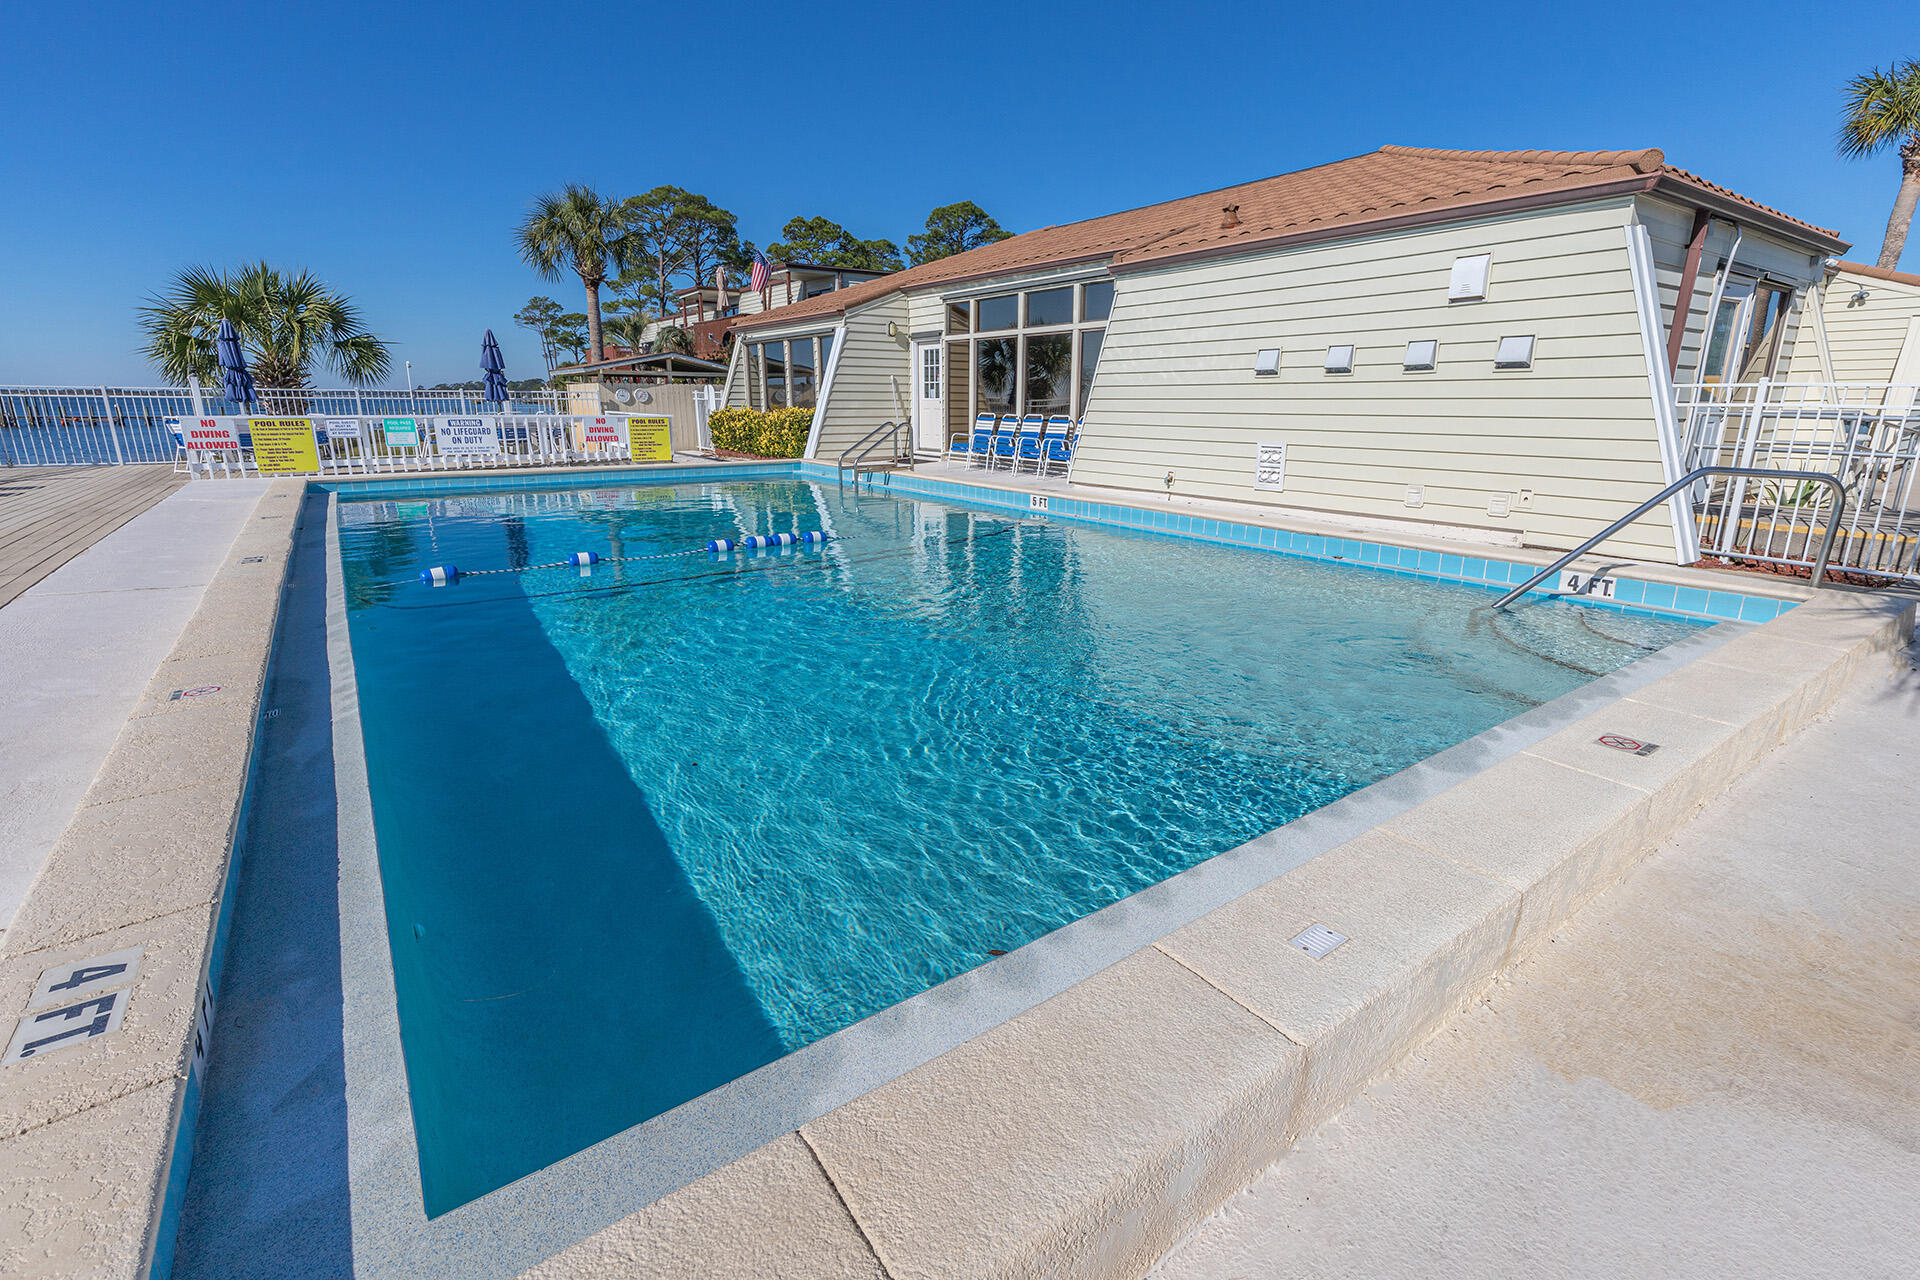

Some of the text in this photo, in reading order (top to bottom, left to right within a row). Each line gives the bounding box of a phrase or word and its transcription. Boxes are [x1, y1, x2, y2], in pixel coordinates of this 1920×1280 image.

[200, 419, 216, 427] NO
[191, 430, 230, 438] DIVING
[187, 441, 238, 449] ALLOWED
[1032, 496, 1037, 506] 5
[1568, 575, 1579, 591] 4
[48, 963, 128, 993] 4
